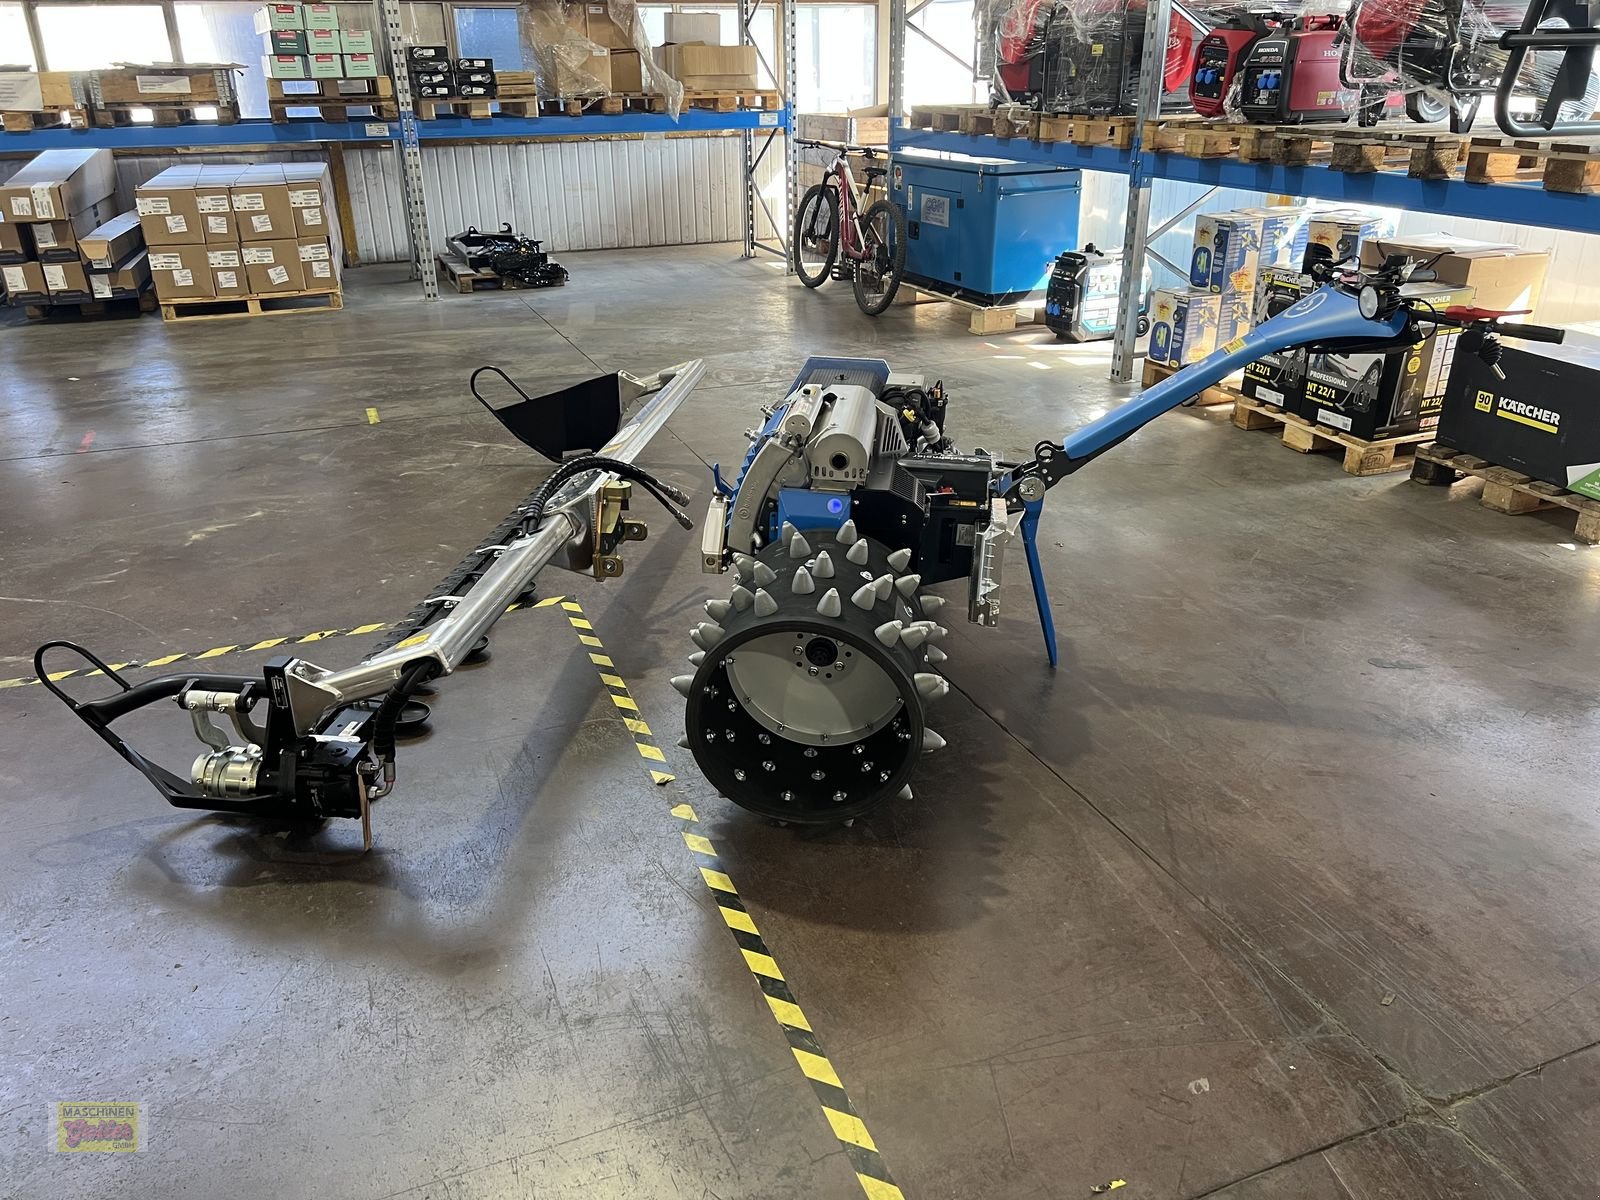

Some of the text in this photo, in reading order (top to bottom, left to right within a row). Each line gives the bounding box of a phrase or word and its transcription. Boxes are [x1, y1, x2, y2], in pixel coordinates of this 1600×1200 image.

[1255, 363, 1271, 376] 22/1
[1309, 370, 1348, 388] PROFESSIONAL
[1306, 381, 1318, 393] NT
[1317, 385, 1336, 399] 22/1
[1420, 398, 1432, 408] NT
[1478, 393, 1561, 426] 90 KÄRCHER
